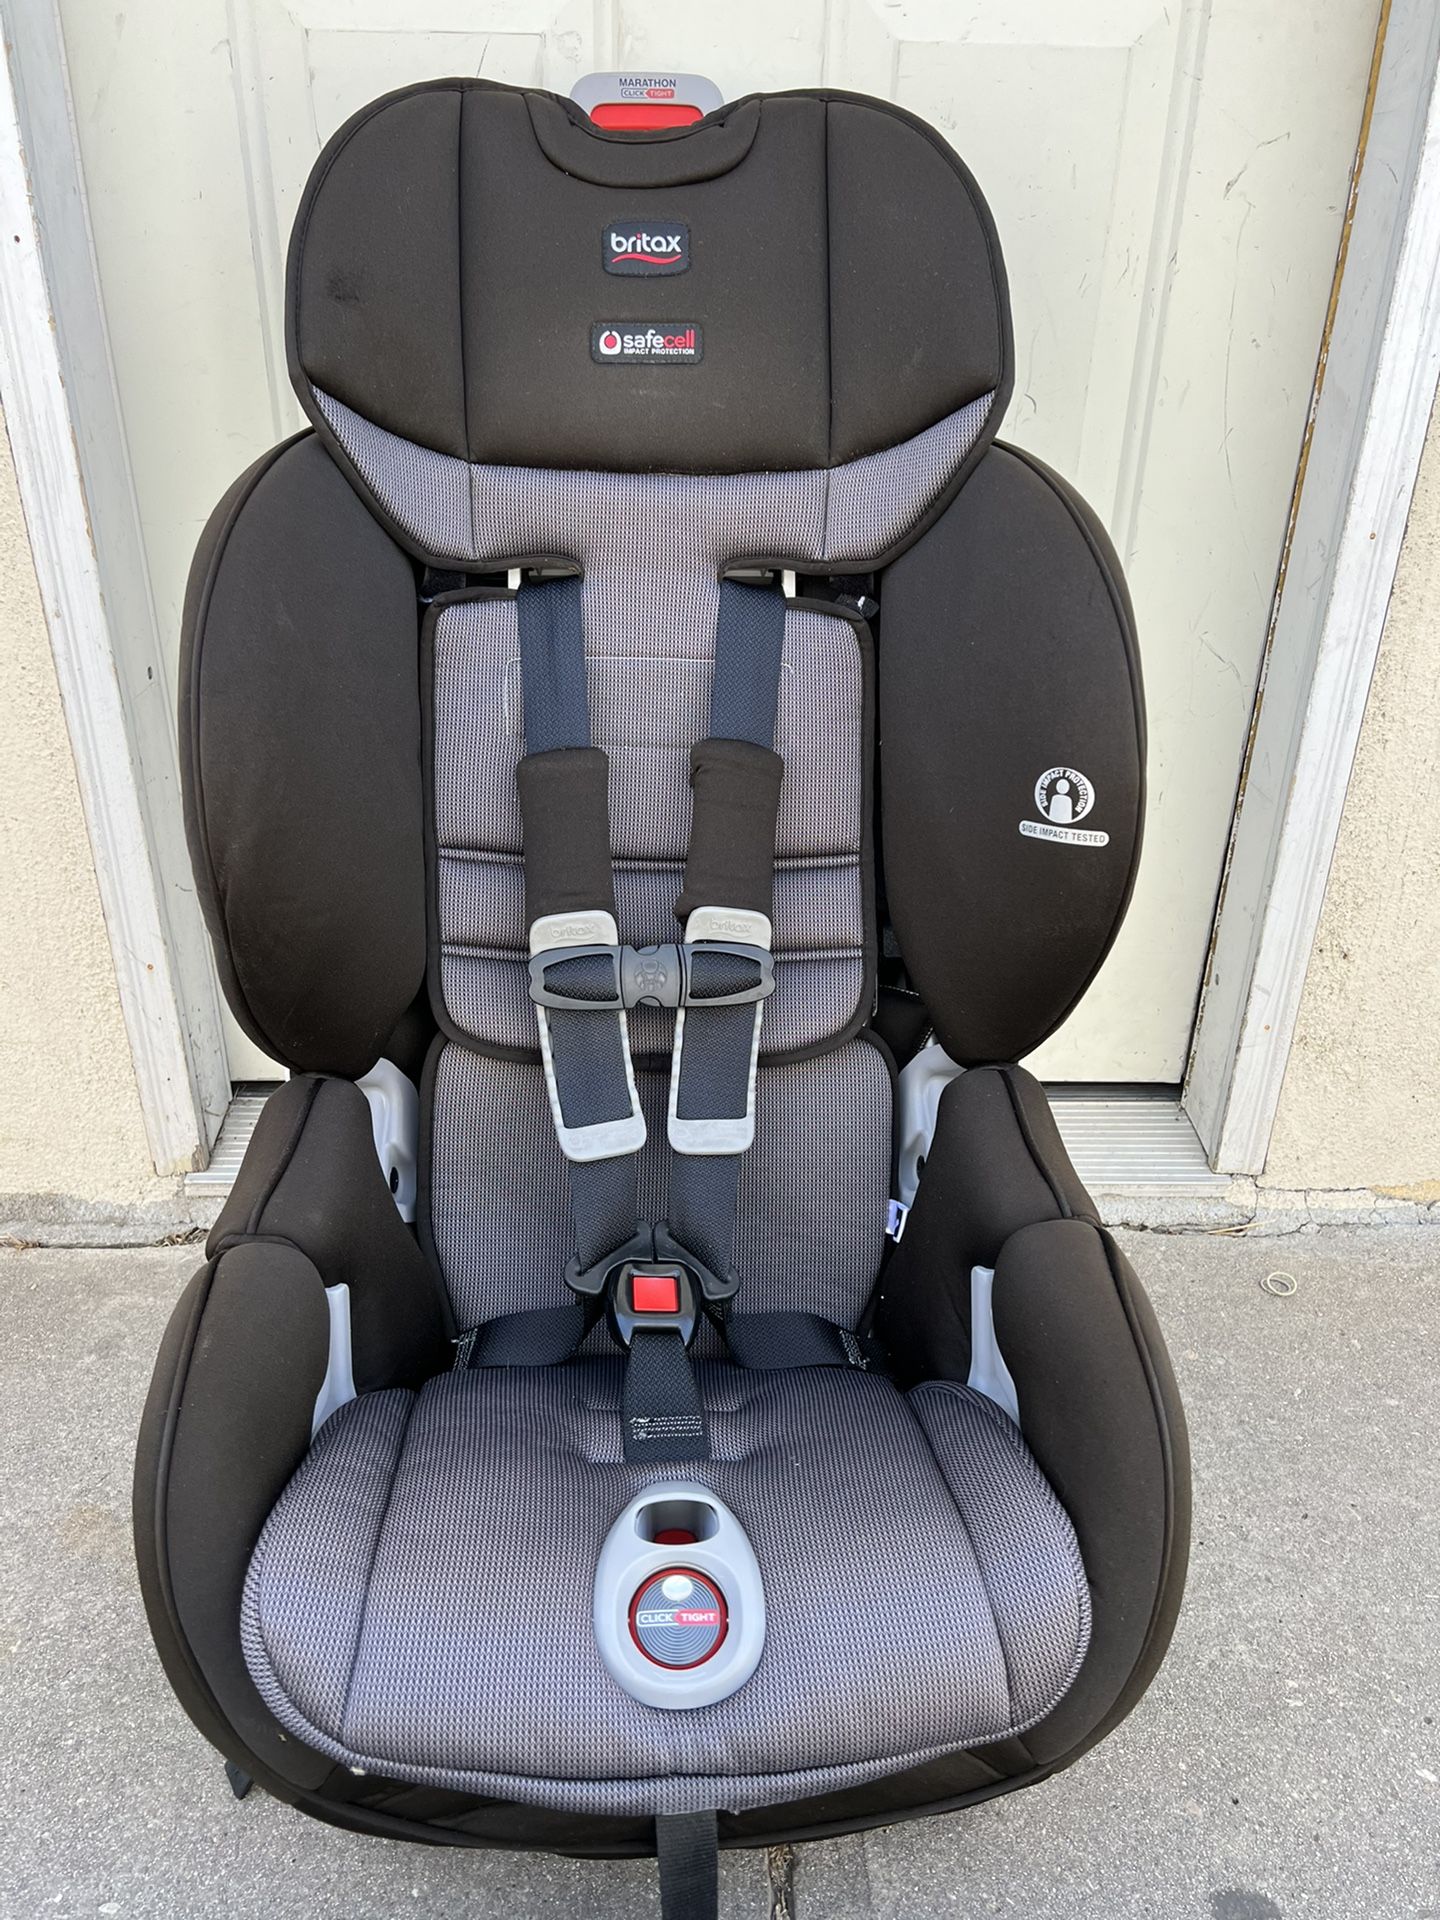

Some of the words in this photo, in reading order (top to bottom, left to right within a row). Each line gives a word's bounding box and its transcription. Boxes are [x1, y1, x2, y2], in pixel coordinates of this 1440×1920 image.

[619, 78, 676, 88] MARATHON
[623, 89, 644, 97] CLICK
[649, 89, 673, 97] TIGHT
[610, 232, 682, 253] britax
[623, 329, 695, 348] safecell
[1041, 769, 1064, 789] IMPACT
[1064, 770, 1088, 813] PROTECTION
[1021, 823, 1038, 835] SIDE
[1039, 827, 1069, 840] IMPACT
[1071, 832, 1106, 843] TESTED
[640, 1613, 673, 1624] CLICK
[680, 1612, 715, 1620] TIGHT
